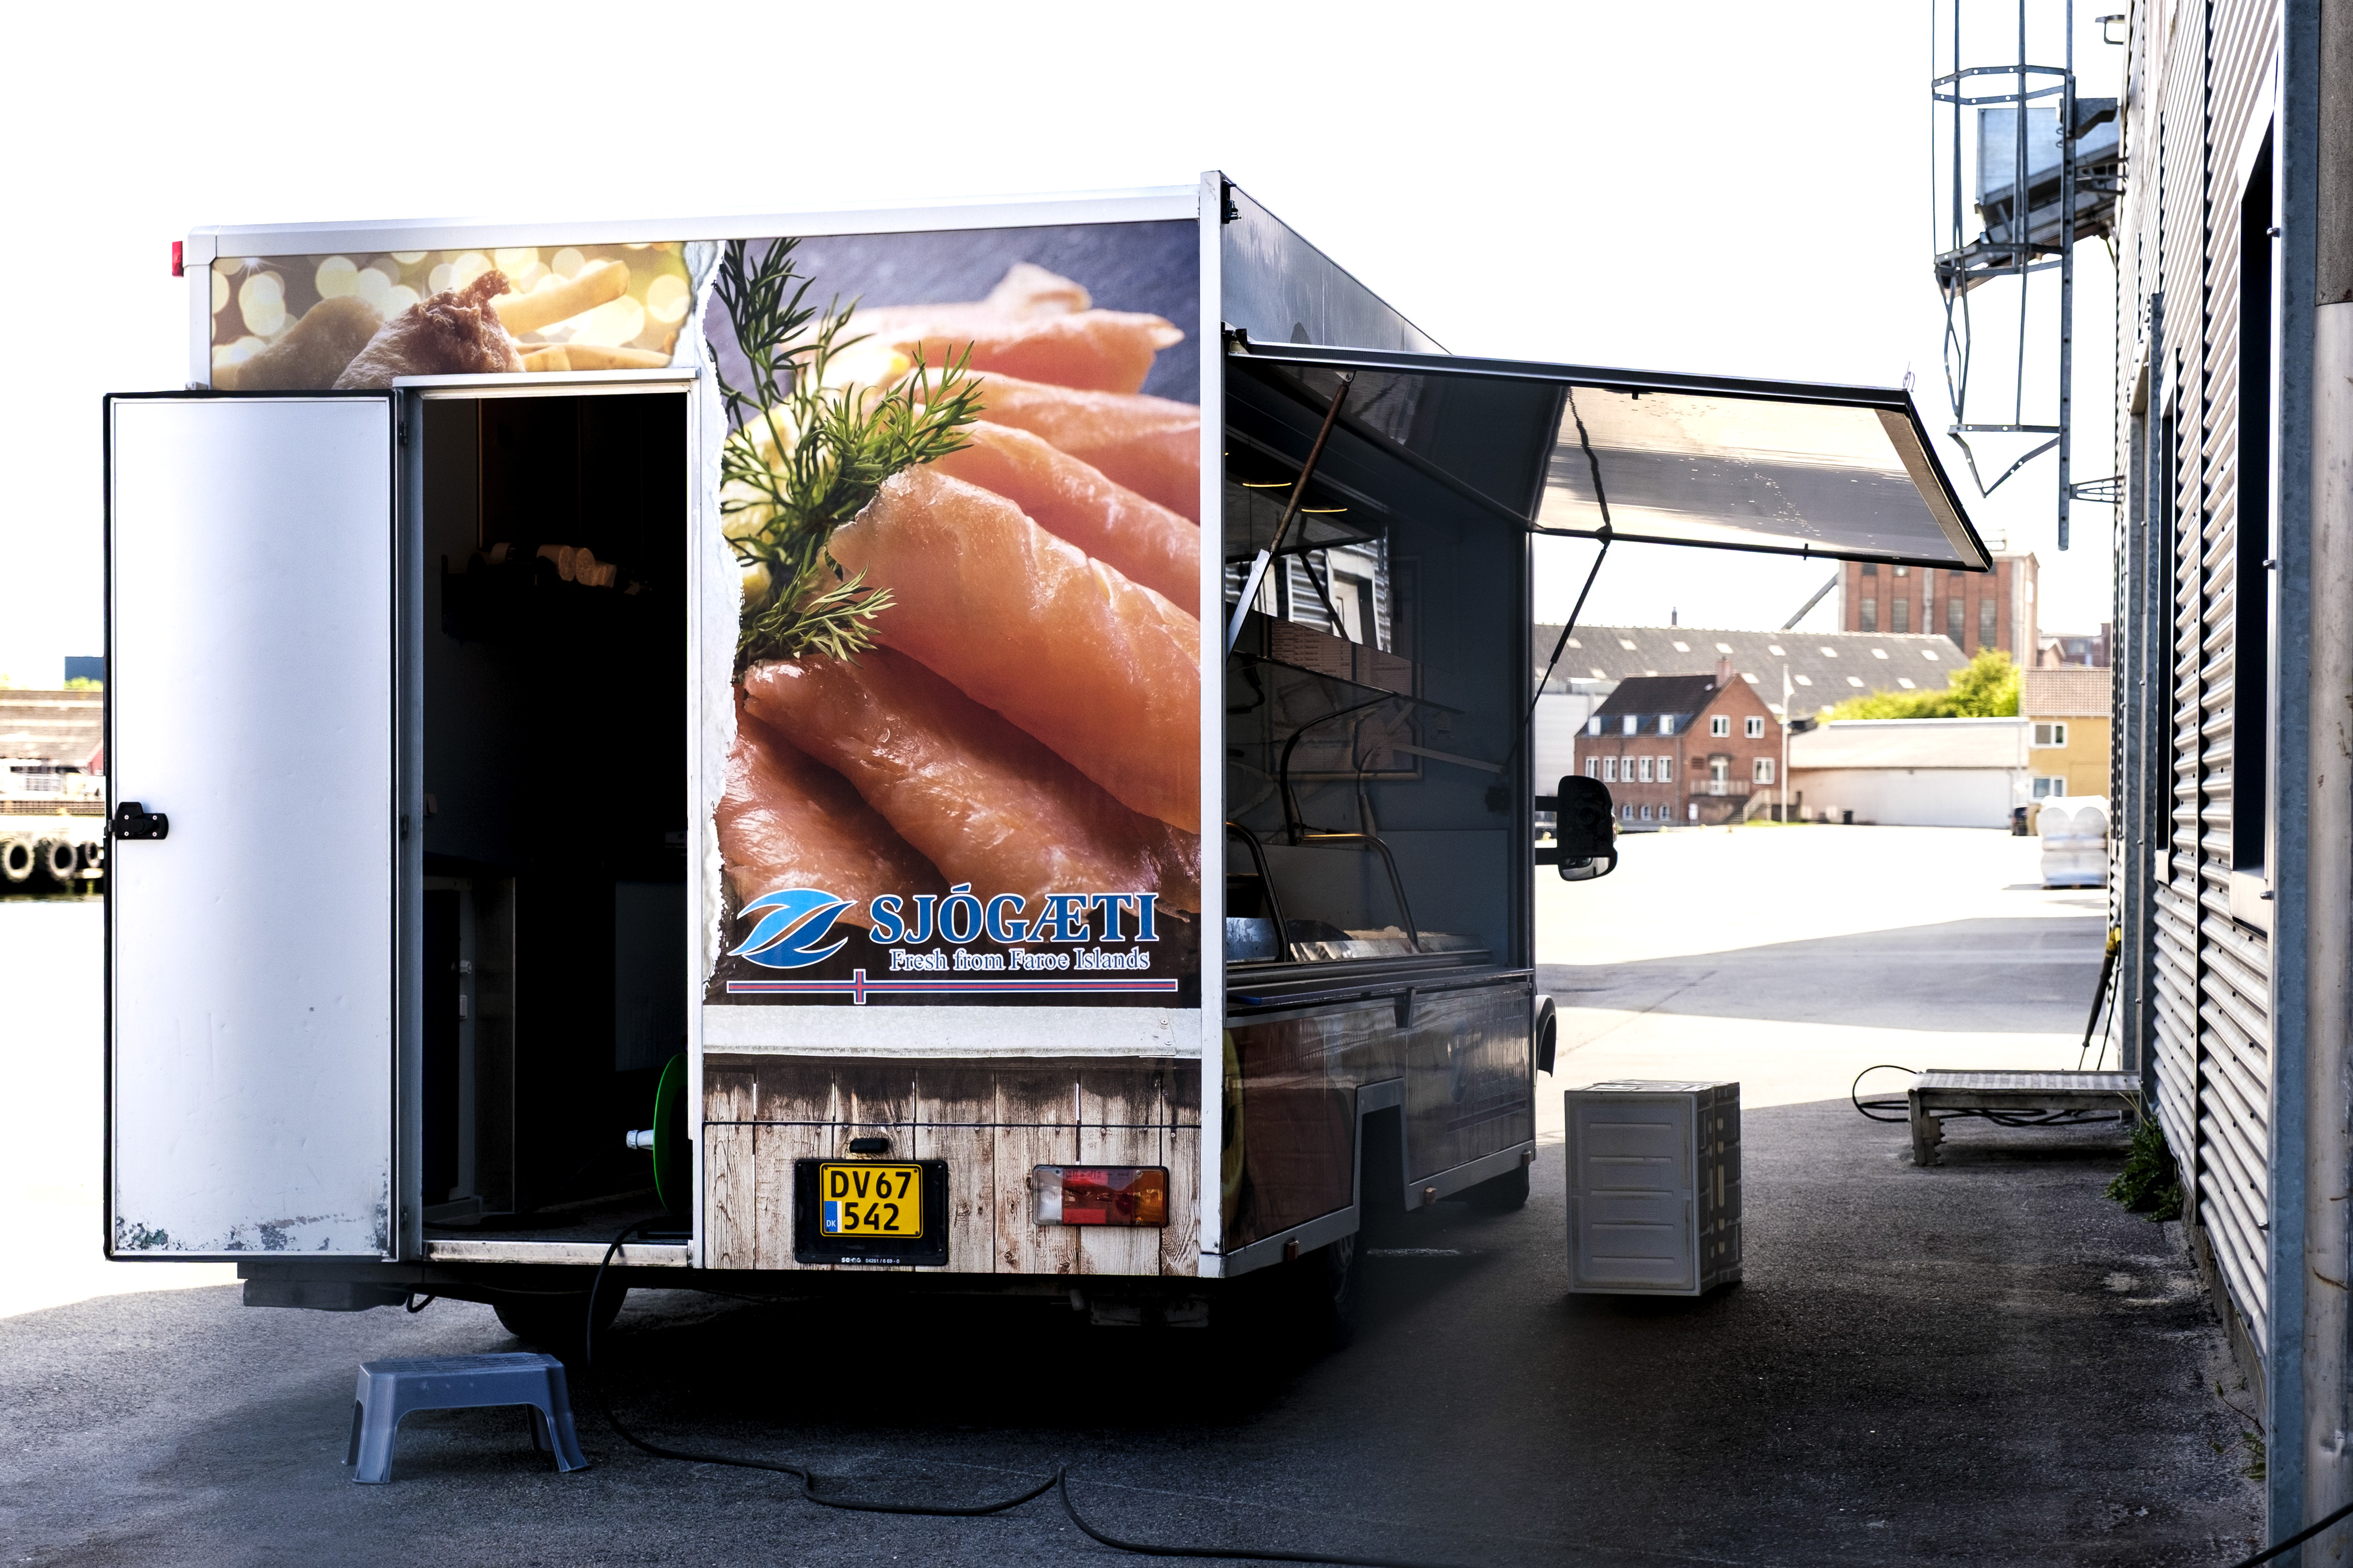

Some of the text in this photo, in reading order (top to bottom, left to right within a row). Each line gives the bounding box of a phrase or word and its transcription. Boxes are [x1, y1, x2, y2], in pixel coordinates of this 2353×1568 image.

[869, 882, 1159, 944] SJÓGÆTI
[889, 946, 1151, 971] Fresh from Faroe Islands
[844, 1202, 899, 1231] 542
